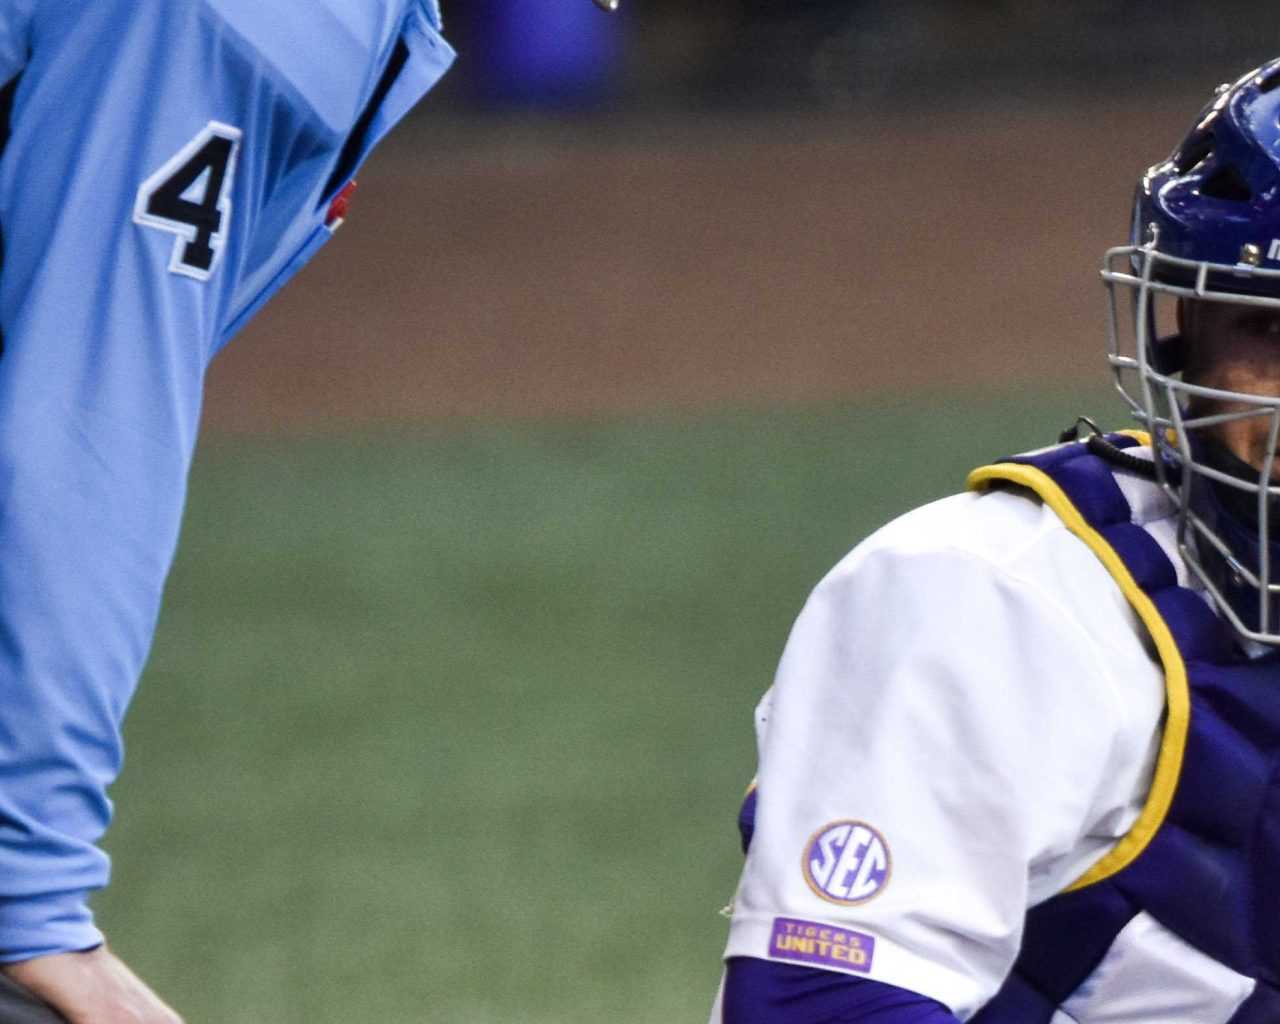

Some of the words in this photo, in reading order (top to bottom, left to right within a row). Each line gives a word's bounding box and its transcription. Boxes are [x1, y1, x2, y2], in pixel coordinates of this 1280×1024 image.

[133, 120, 242, 281] 4
[810, 824, 887, 900] SEC
[775, 933, 867, 965] UNITED
